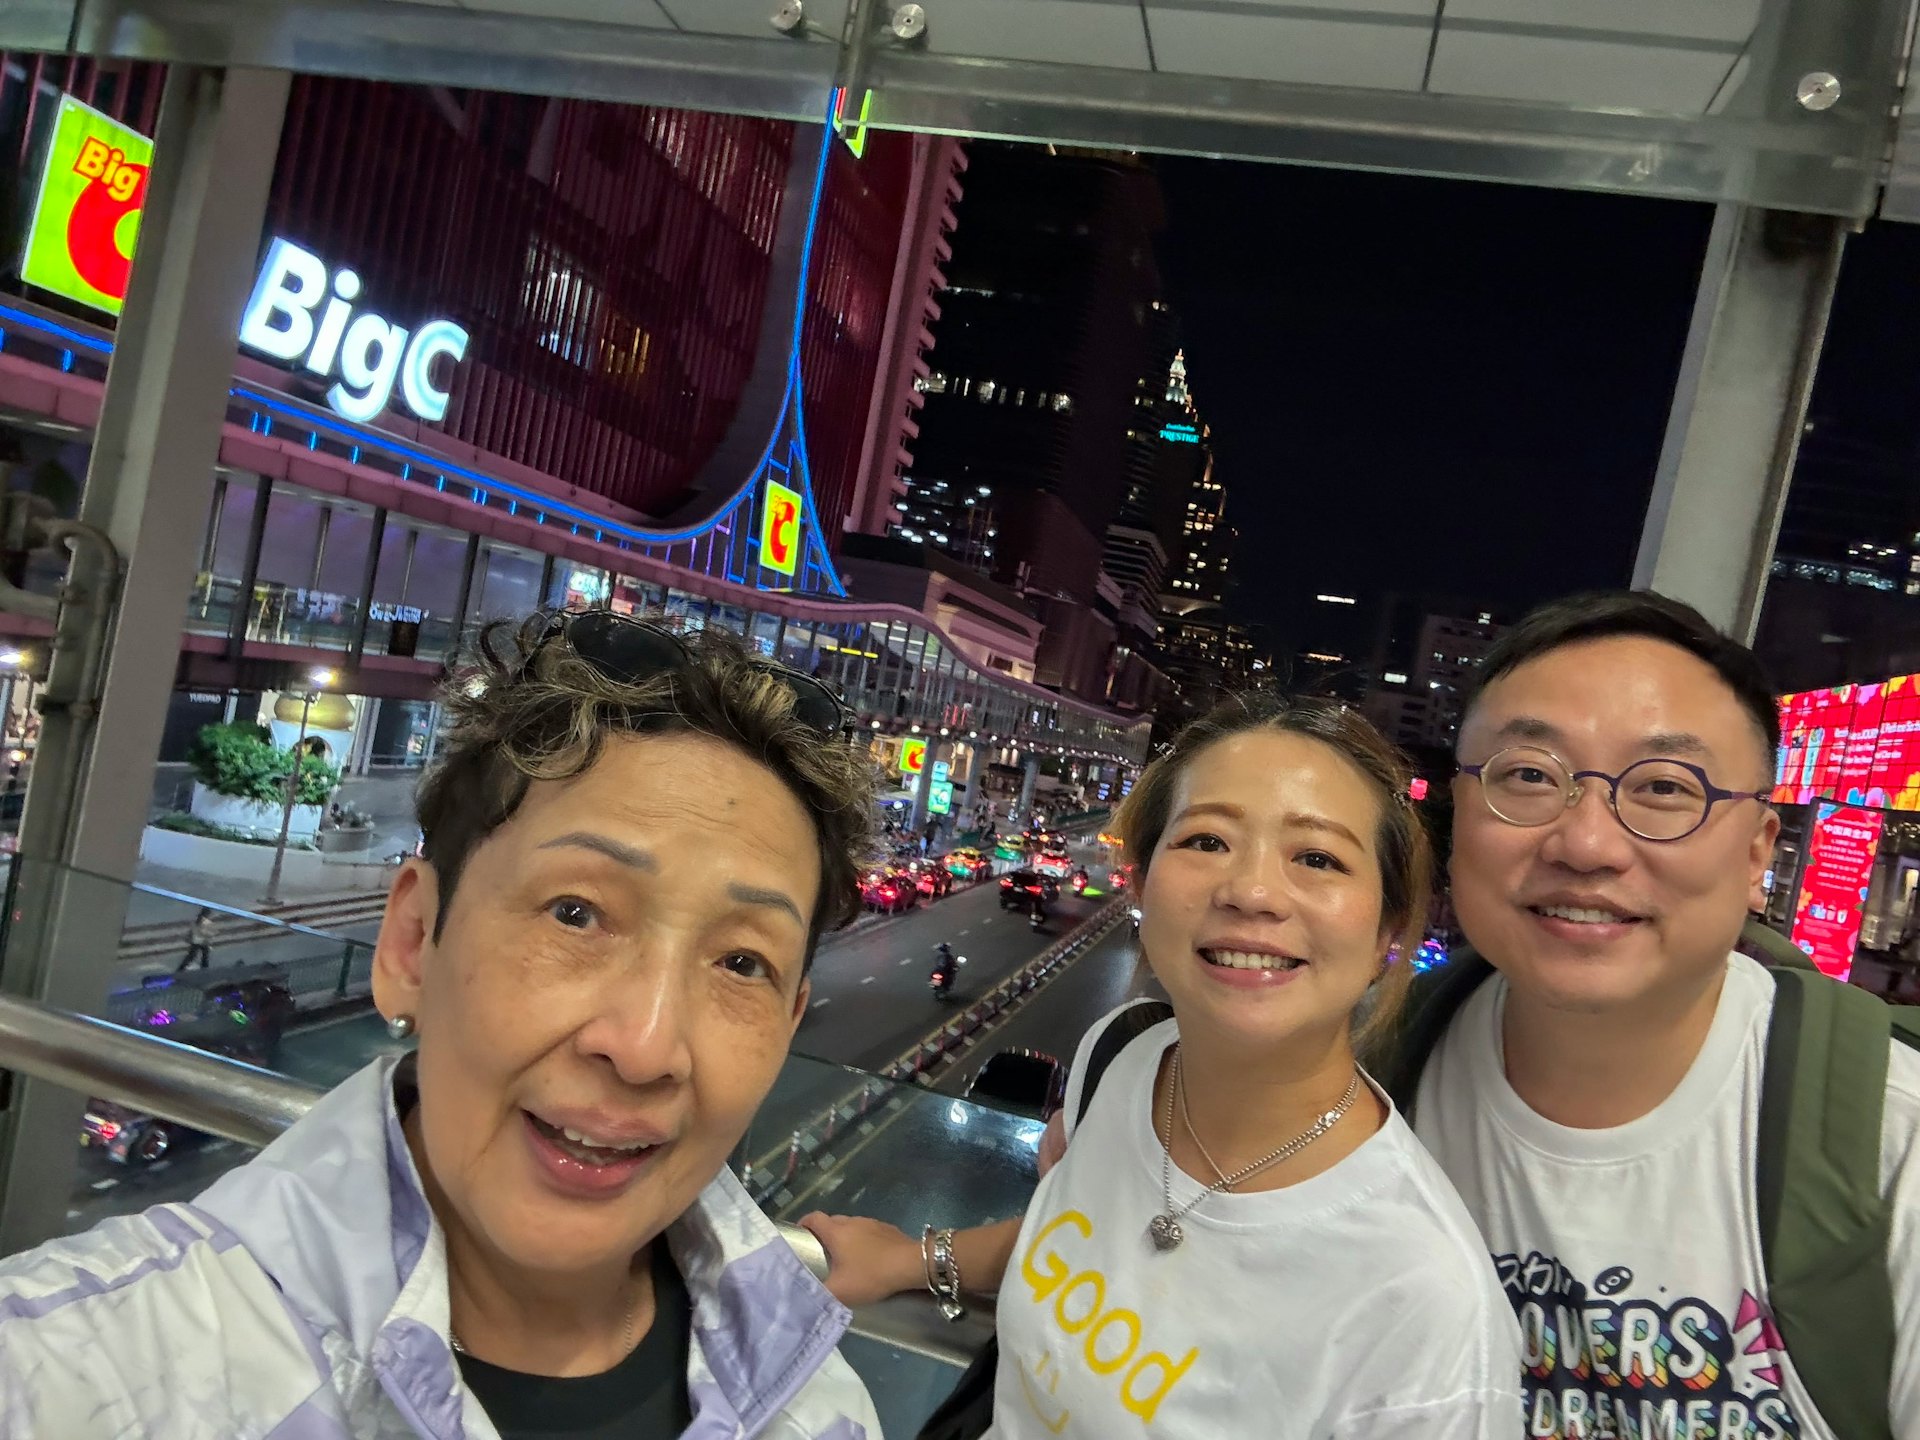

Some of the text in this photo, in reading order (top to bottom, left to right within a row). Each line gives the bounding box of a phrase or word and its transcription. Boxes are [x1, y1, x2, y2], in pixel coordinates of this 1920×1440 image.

[73, 135, 141, 202] Big
[1021, 1209, 1200, 1424] Good
[1520, 1301, 1716, 1386] OVERS
